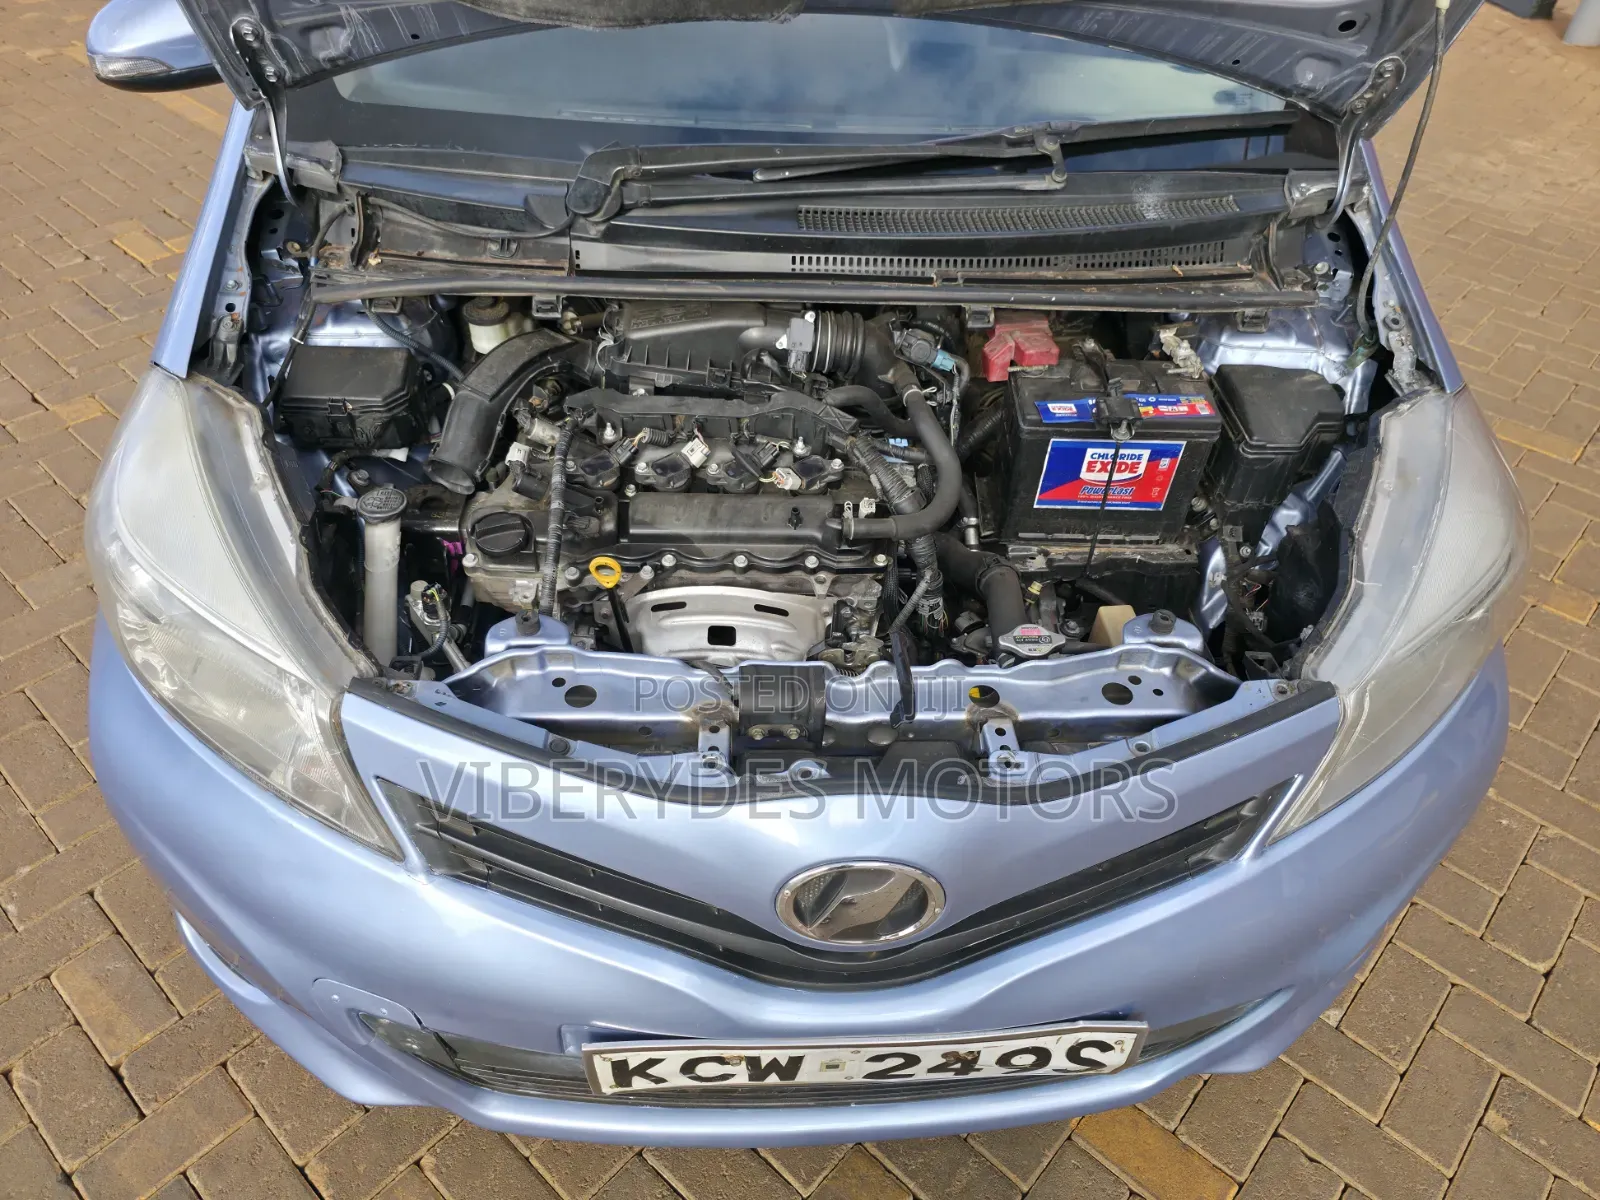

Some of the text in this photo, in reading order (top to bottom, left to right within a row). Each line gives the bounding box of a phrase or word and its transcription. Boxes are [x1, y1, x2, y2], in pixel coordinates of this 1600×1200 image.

[1086, 460, 1142, 474] EXDE
[611, 1039, 1117, 1088] KCW 249S
